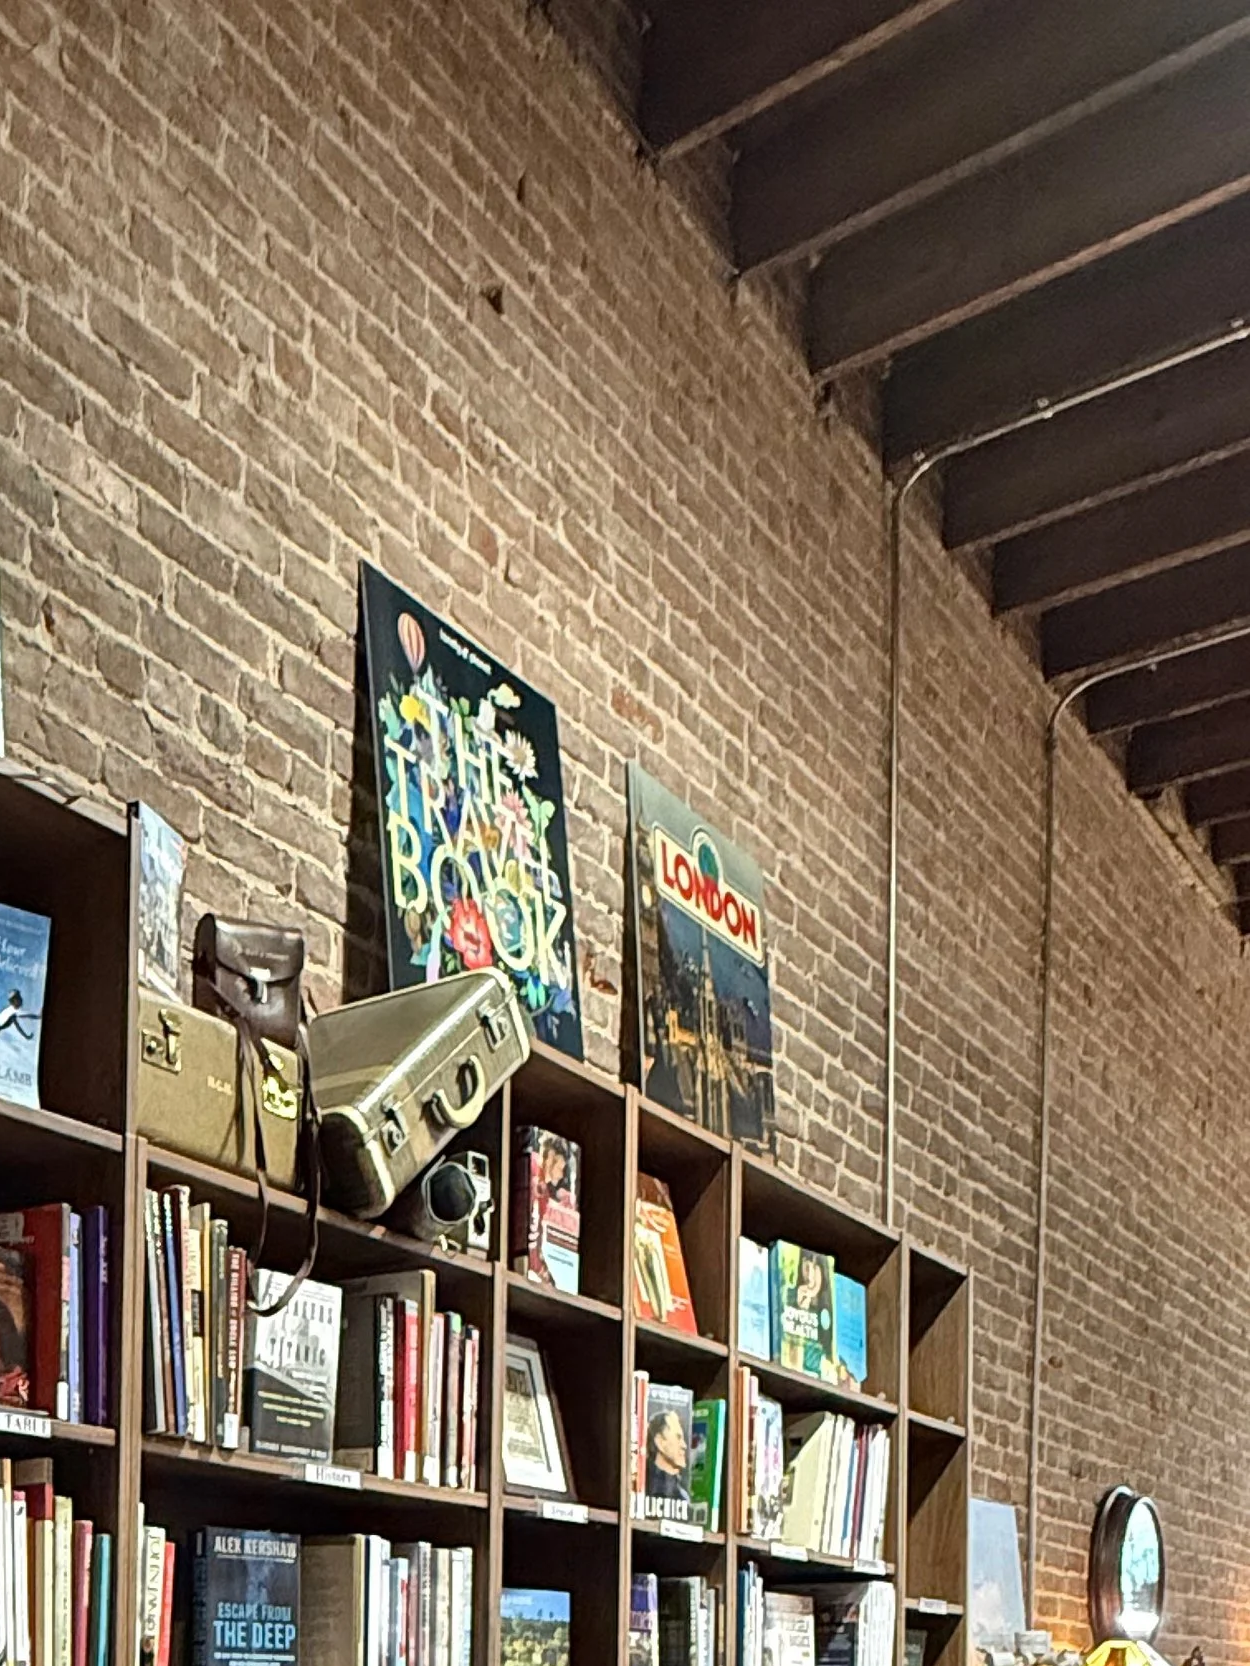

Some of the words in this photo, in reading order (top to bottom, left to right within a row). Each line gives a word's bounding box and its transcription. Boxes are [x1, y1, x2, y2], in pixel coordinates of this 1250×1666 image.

[416, 685, 514, 807] THE
[388, 808, 568, 990] BOOK
[661, 838, 757, 951] LONDON
[213, 1535, 241, 1555] ALEX
[242, 1536, 298, 1559] KERSHAW
[212, 1619, 246, 1649] THE
[250, 1621, 296, 1651] DEEP
[217, 1601, 259, 1620] ESCAPE
[261, 1604, 292, 1622] FROM
